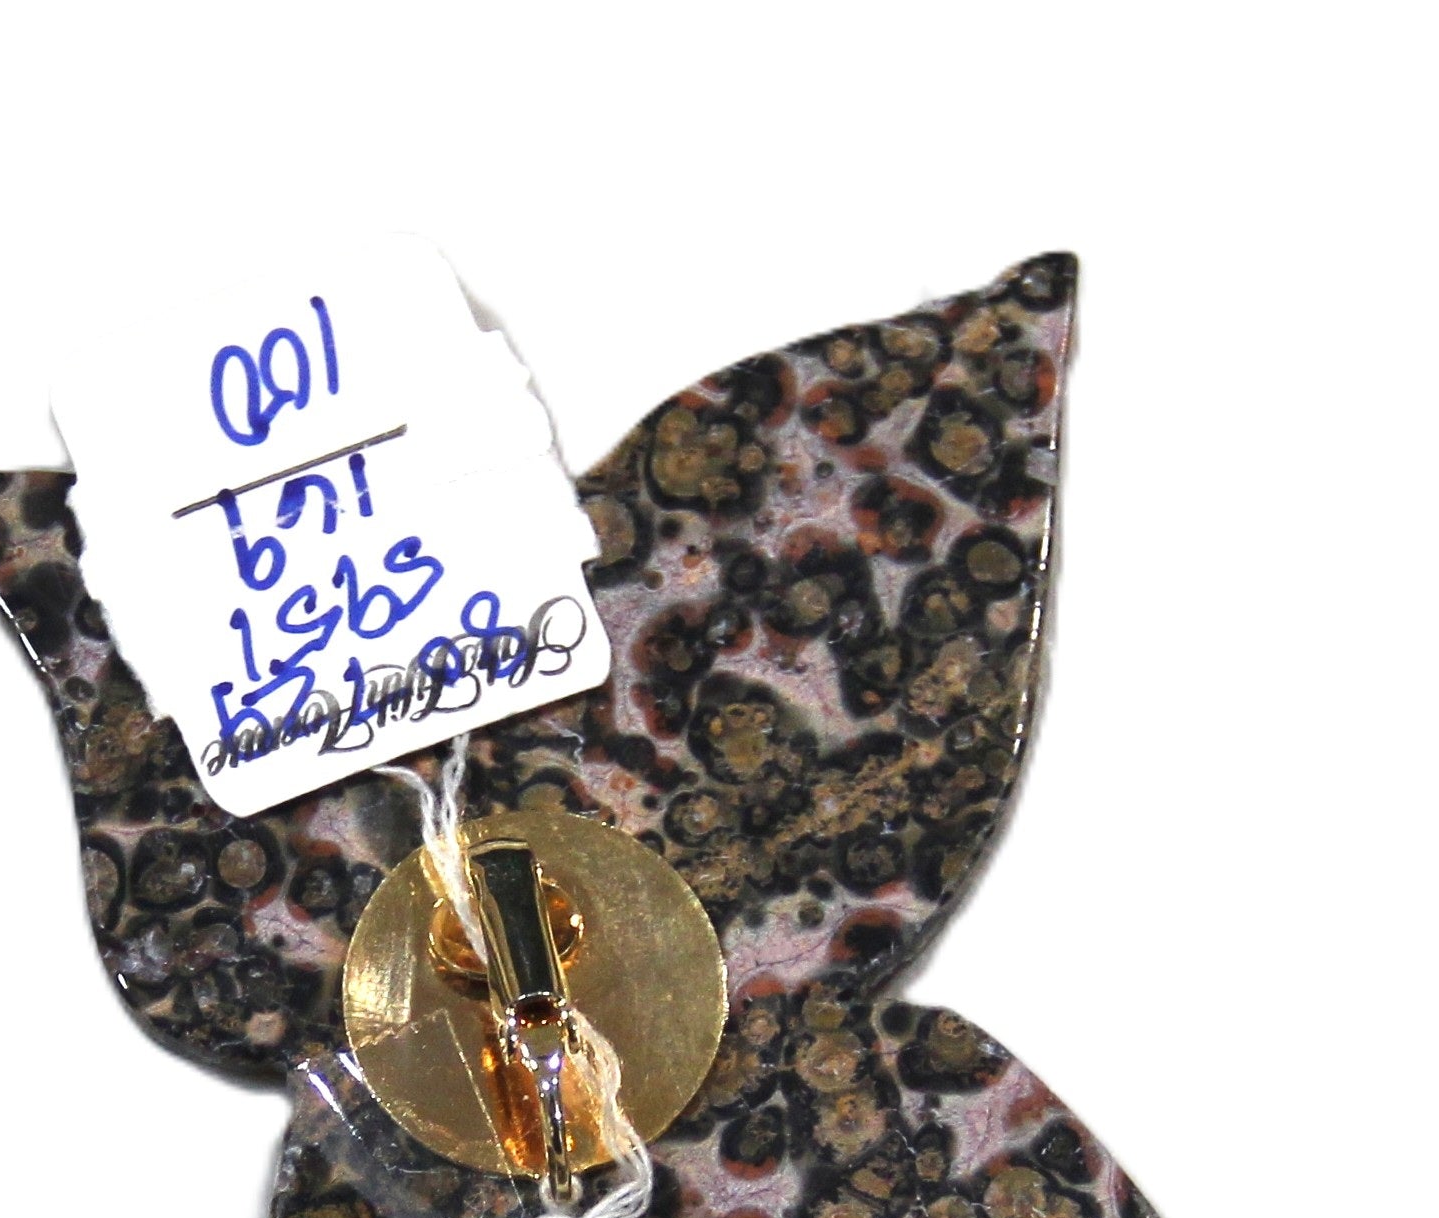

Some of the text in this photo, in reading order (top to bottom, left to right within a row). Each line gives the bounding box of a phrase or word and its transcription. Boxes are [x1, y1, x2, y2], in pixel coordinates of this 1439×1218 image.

[210, 297, 340, 447] 100
[218, 454, 375, 592] 169
[362, 634, 481, 727] Fifth
